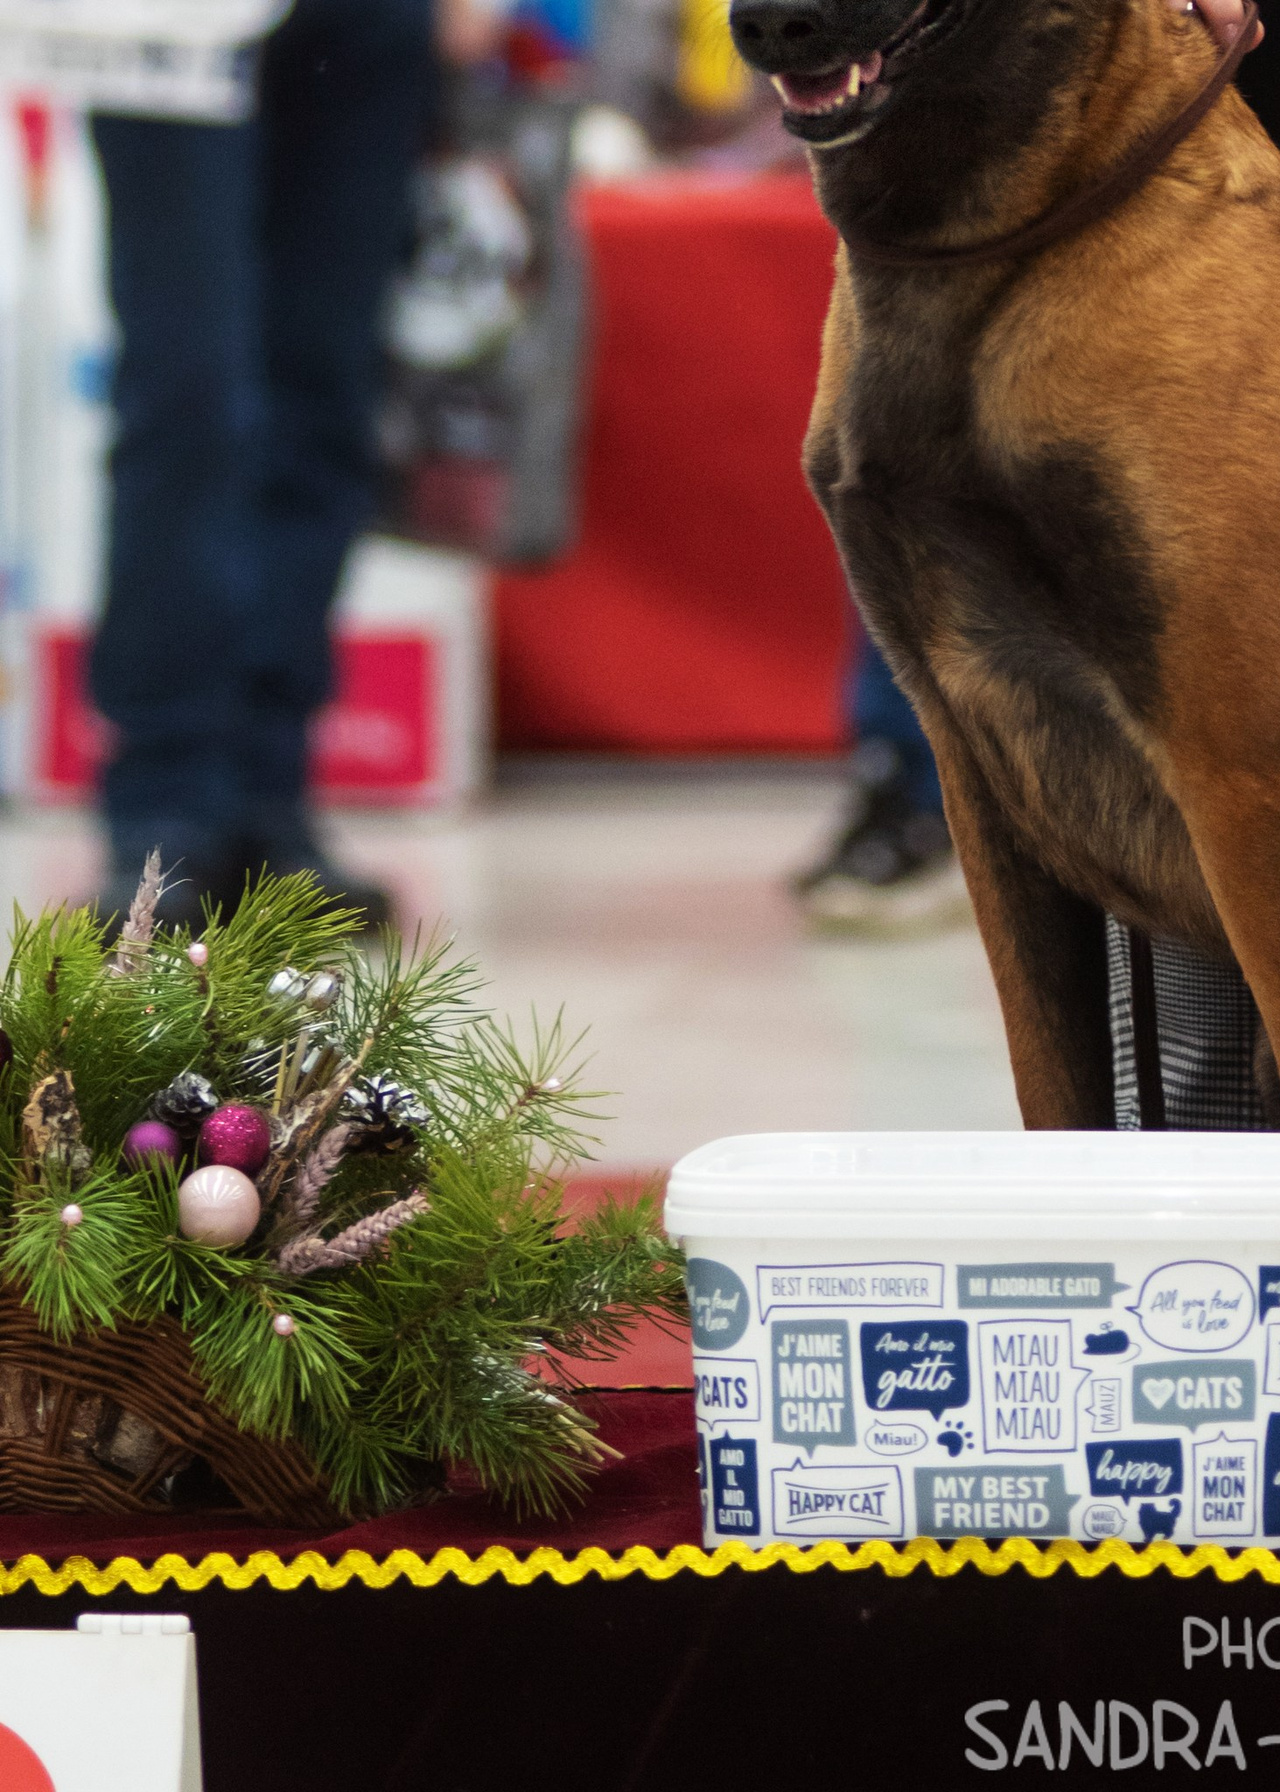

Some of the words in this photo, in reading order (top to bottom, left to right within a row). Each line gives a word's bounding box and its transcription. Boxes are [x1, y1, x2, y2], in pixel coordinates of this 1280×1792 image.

[771, 1277, 801, 1297] BEST
[808, 1276, 867, 1298] FRIENDS
[871, 1277, 930, 1298] FOREVER
[969, 1277, 987, 1296] MI
[989, 1277, 1061, 1297] ADORABLE
[1064, 1277, 1101, 1296] GATO
[1150, 1290, 1177, 1312] All
[1182, 1299, 1206, 1315] you
[1197, 1311, 1229, 1333] love
[778, 1334, 844, 1359] J'AIME
[875, 1332, 910, 1353] Amo
[912, 1332, 930, 1352] il
[993, 1334, 1058, 1367] MIAU
[779, 1362, 844, 1399] MON
[876, 1354, 957, 1408] gatto
[995, 1371, 1060, 1403] MIAU
[1175, 1376, 1244, 1410] CATS
[780, 1402, 845, 1433] CHAT
[1099, 1384, 1116, 1426] MAUZ
[996, 1408, 1061, 1440] MIAU
[873, 1431, 918, 1446] Miau!
[720, 1449, 745, 1466] AMO
[1203, 1456, 1246, 1471] J'AIME
[1096, 1448, 1173, 1493] happy
[723, 1489, 745, 1506] MIO
[933, 1476, 977, 1500] MY
[981, 1476, 1050, 1500] BEST
[1203, 1475, 1246, 1499] MON
[788, 1489, 846, 1517] HAPPY
[848, 1489, 886, 1517] CAT
[933, 1502, 1051, 1529] FRIEND
[1203, 1501, 1245, 1522] CHAT
[718, 1508, 753, 1527] GATTO
